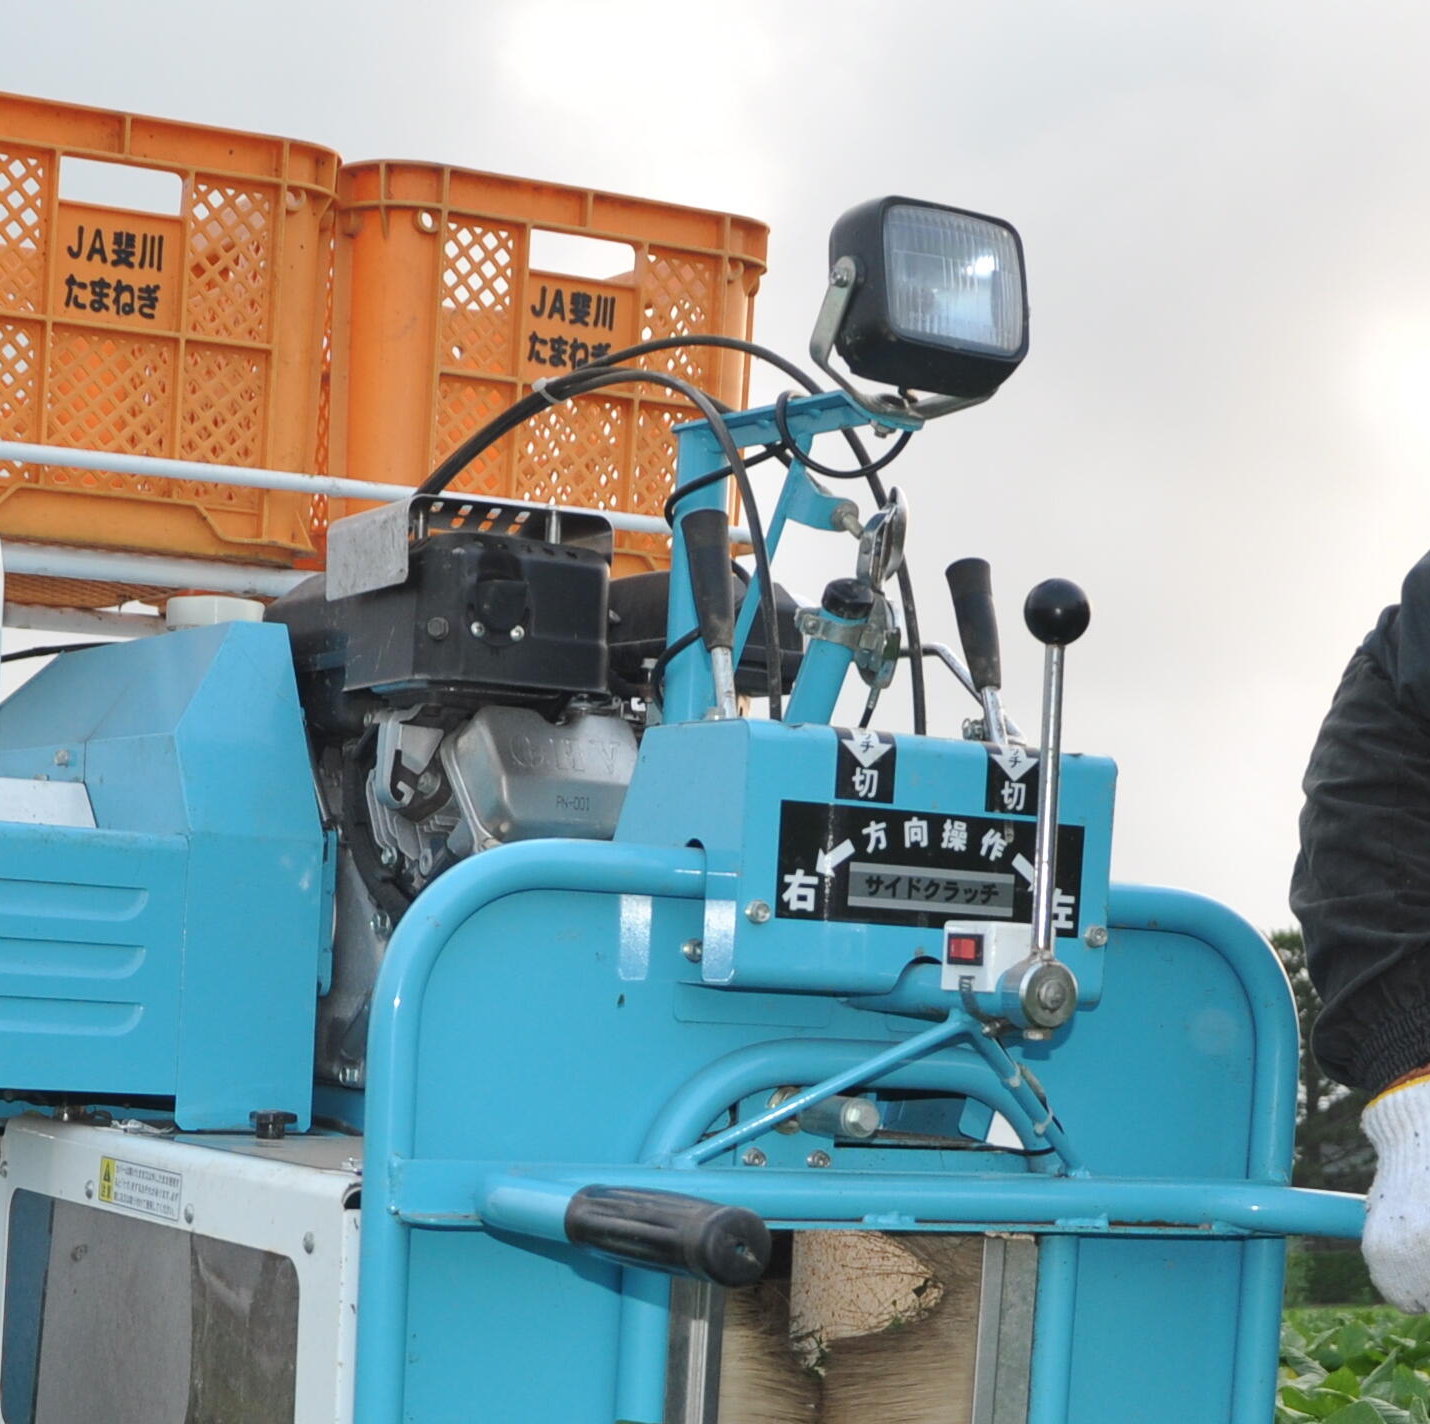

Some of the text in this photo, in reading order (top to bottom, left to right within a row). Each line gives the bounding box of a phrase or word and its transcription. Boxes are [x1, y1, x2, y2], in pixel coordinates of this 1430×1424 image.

[65, 274, 161, 320] たまねぎ
[852, 767, 878, 798] 切
[1001, 781, 1026, 811] 切
[861, 816, 1008, 862] 方向操作
[782, 868, 819, 912] 右
[865, 875, 999, 905] サイドクラッチ
